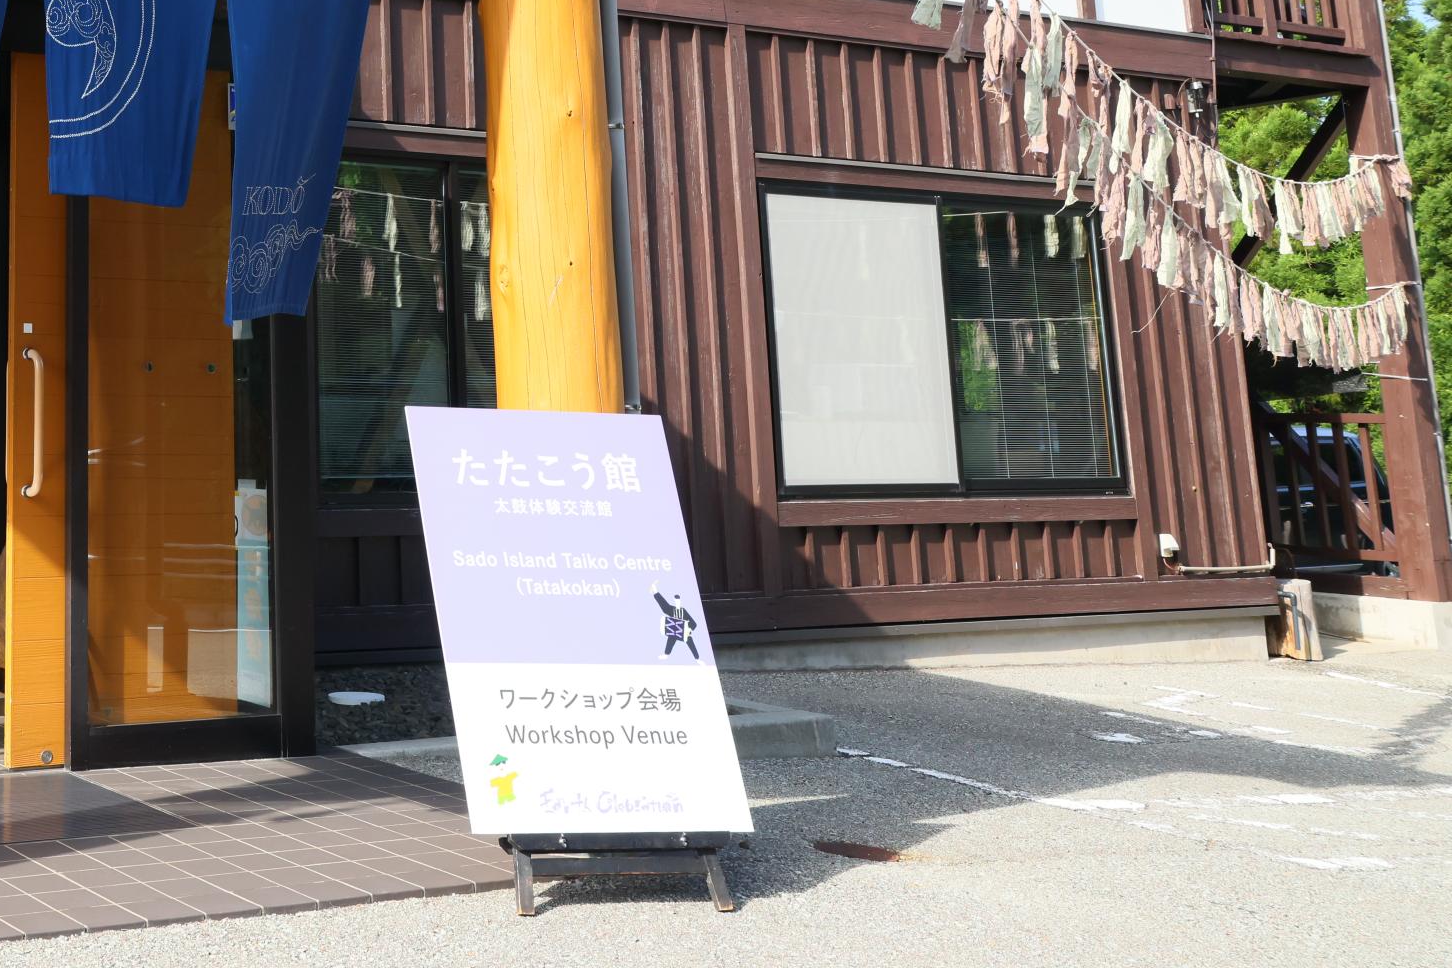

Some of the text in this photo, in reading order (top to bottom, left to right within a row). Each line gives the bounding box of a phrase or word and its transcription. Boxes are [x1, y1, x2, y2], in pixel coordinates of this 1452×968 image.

[452, 448, 642, 493] たたこう館
[494, 498, 613, 518] 太鼓体験交流館
[452, 550, 672, 572] Sado Island Taiko Centre
[516, 577, 621, 598] (Tatakokan)
[499, 687, 682, 712] ワークショップ会場
[505, 724, 689, 749] Workshop Venue
